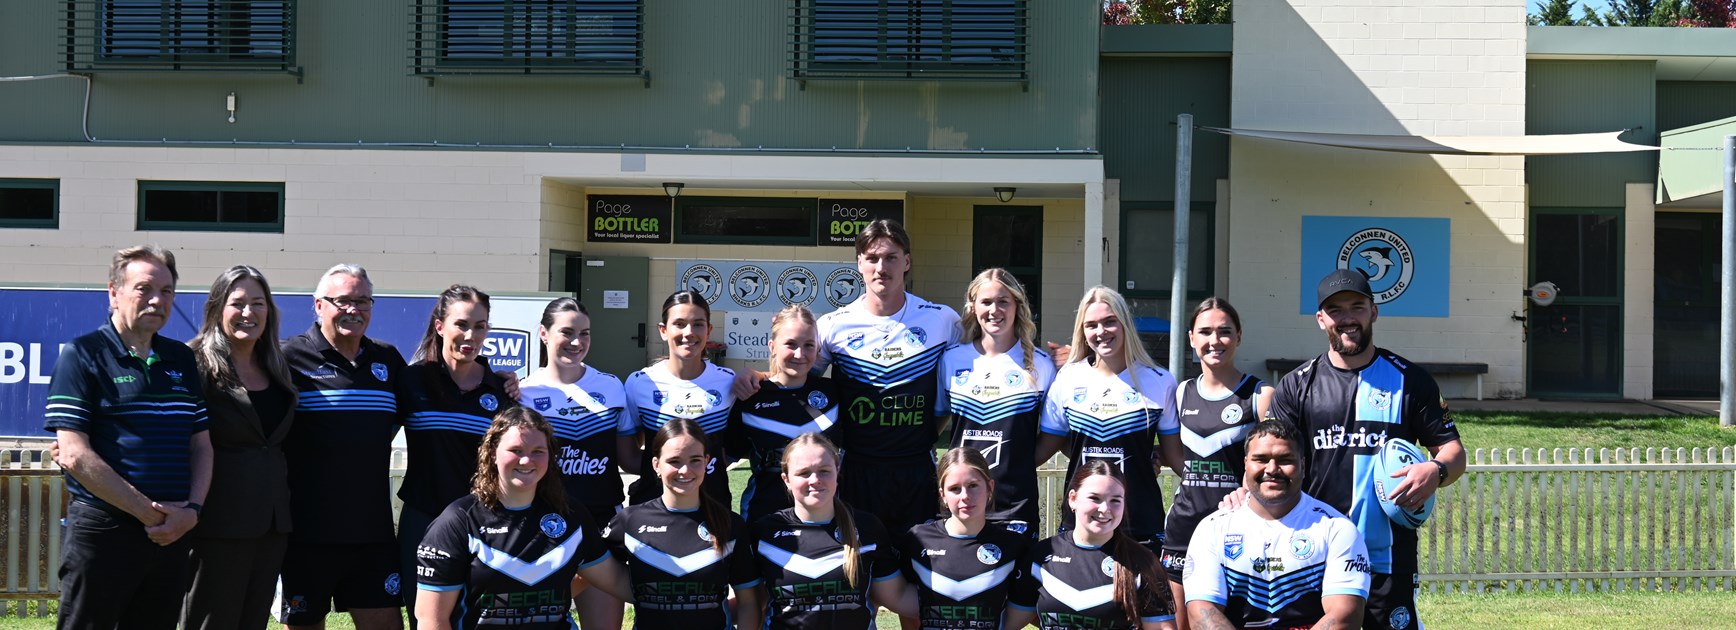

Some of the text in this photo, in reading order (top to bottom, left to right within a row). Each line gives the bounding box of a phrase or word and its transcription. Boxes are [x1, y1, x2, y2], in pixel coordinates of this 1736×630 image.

[596, 200, 632, 218] Page
[832, 203, 868, 220] Page
[594, 216, 659, 232] BOTTLER
[1340, 231, 1410, 263] BELCONNEN UNITED
[708, 267, 720, 284] UNITED
[756, 269, 768, 286] UNITED
[803, 270, 816, 286] UNITED
[851, 271, 864, 287] UNITED
[728, 332, 768, 346] Stead
[479, 338, 523, 357] SW
[746, 348, 768, 358] Stru
[881, 395, 925, 409] CLUB
[880, 411, 924, 426] LIME
[560, 445, 580, 458] The
[558, 451, 609, 475] adies
[1172, 556, 1186, 566] ICO
[1356, 554, 1365, 562] The
[1344, 559, 1372, 575] Trad
[480, 608, 522, 617] STEEL
[540, 605, 564, 614] FOR
